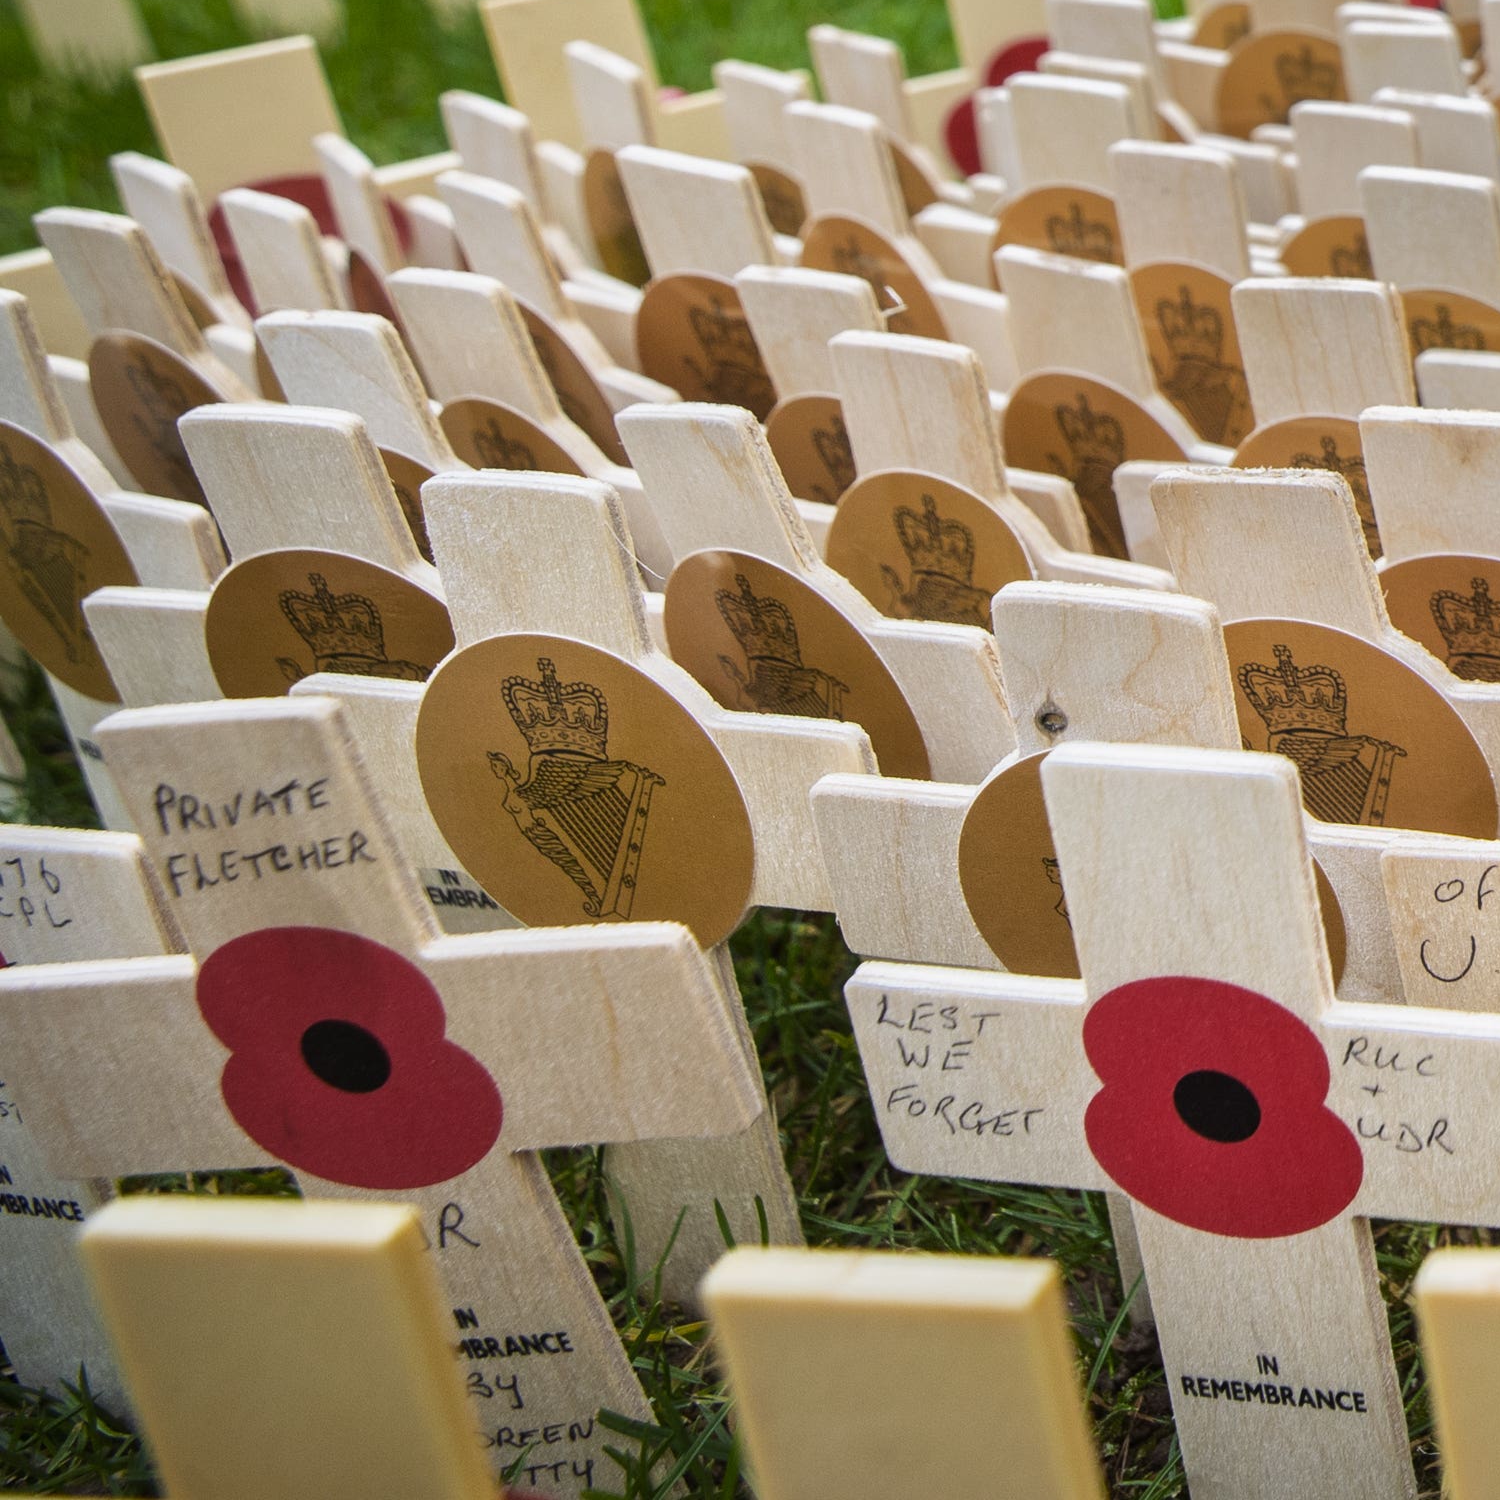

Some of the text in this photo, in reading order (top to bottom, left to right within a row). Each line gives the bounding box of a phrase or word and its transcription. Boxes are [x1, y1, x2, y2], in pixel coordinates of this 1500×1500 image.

[154, 777, 331, 836] PRIVATE
[164, 829, 379, 897] FLETCHER
[425, 886, 500, 910] EMBRA
[1433, 863, 1500, 912] OF
[876, 993, 1001, 1038] LEST
[895, 1036, 974, 1072] WE
[1342, 1036, 1439, 1077] RUC
[886, 1083, 1046, 1137] FORGET
[1356, 1116, 1454, 1155] UDR
[458, 1331, 575, 1360] BRANCE
[1255, 1354, 1280, 1377] IN
[1180, 1374, 1368, 1414] REMEMBRANCE
